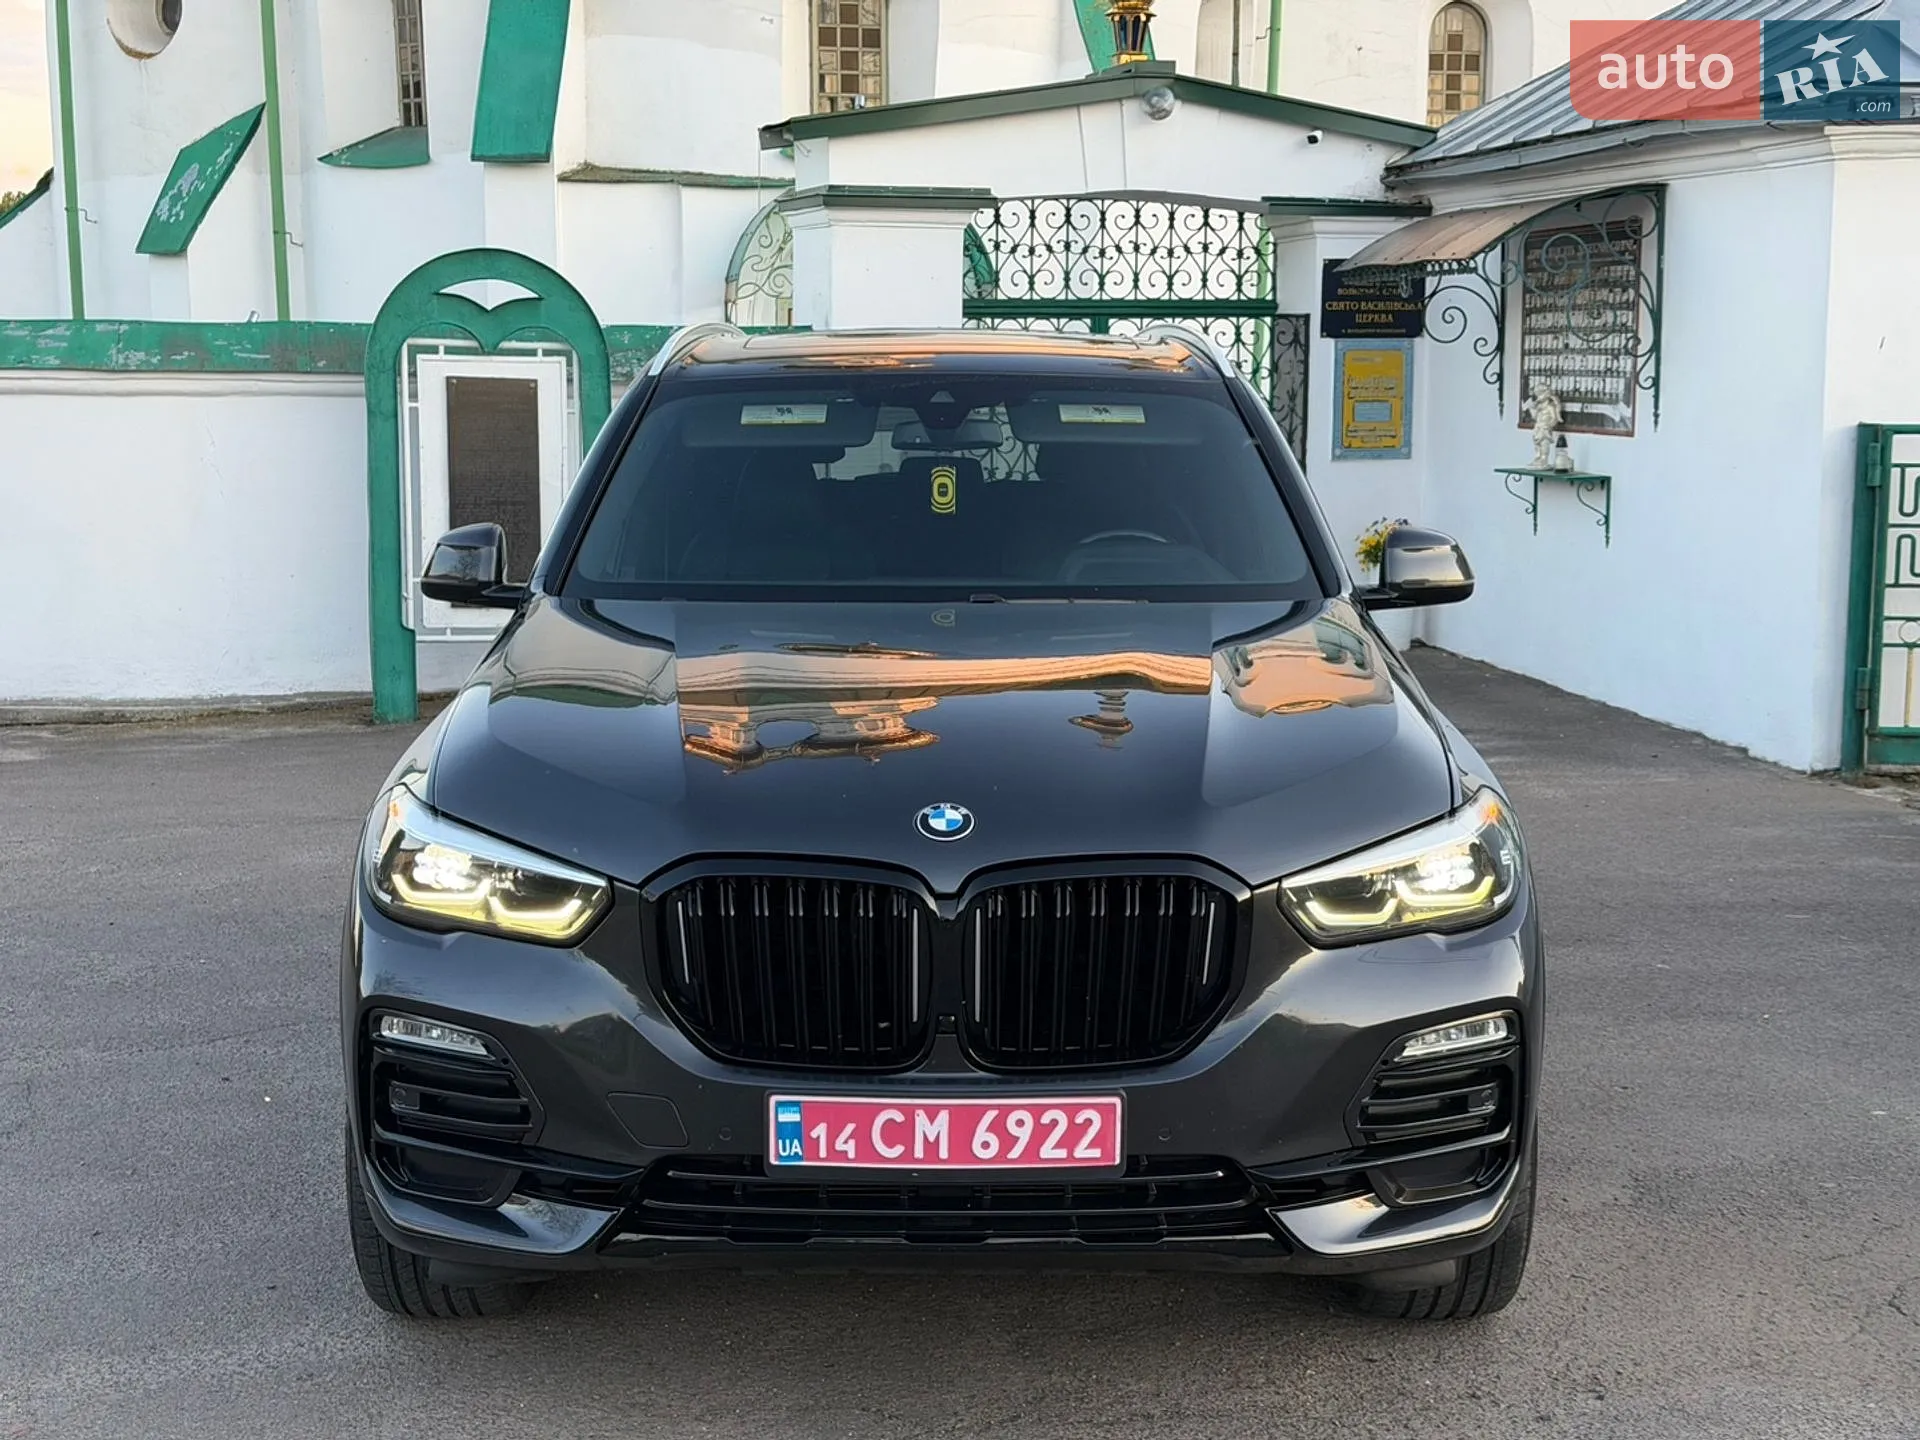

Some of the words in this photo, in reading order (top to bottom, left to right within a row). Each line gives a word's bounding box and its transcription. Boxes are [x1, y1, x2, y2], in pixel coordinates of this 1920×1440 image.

[1325, 301, 1359, 311] СВЯТО
[1355, 313, 1394, 323] ЦЕРКВА
[778, 1138, 803, 1157] UA
[809, 1122, 857, 1159] 14
[871, 1108, 950, 1160] CM
[971, 1108, 1103, 1160] 6922
